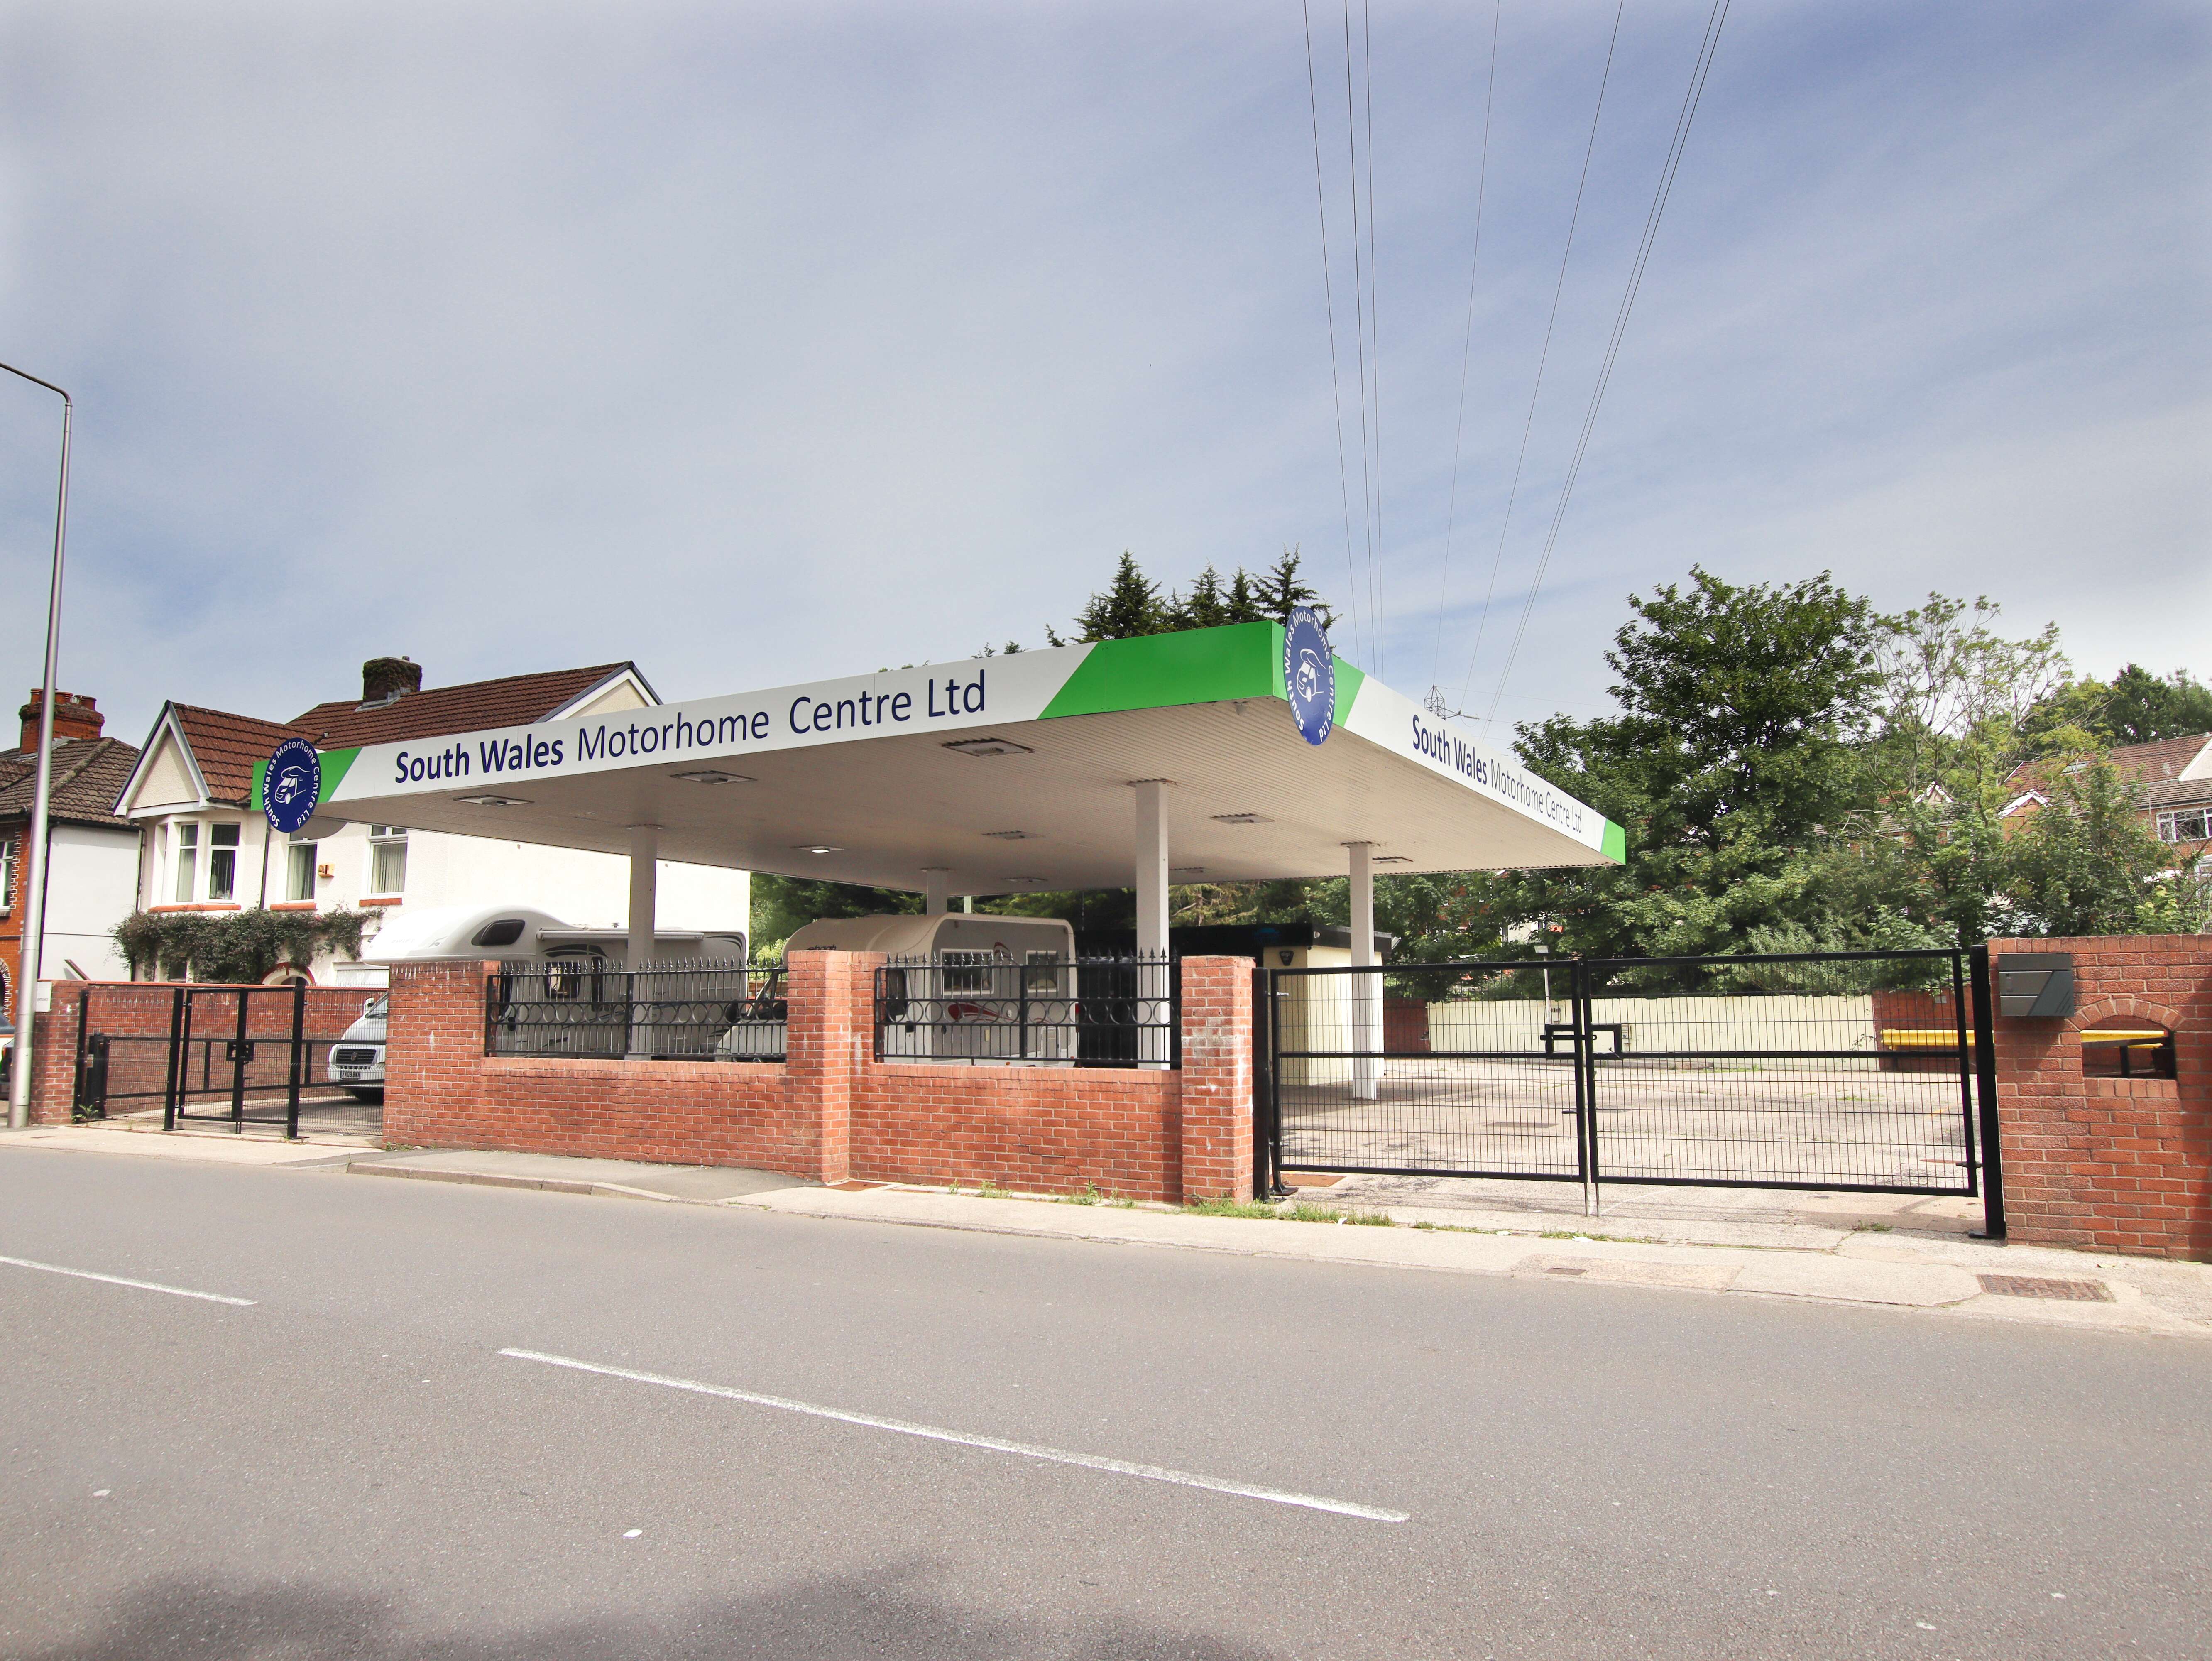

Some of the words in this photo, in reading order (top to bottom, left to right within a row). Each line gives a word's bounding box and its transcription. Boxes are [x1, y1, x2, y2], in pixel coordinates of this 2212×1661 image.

[1285, 624, 1294, 674] Wales
[1293, 610, 1330, 660] Motorhome
[395, 743, 470, 783] South
[480, 734, 563, 773] Wales
[578, 712, 769, 761] Motorhome
[790, 693, 912, 734] Centre
[927, 669, 986, 718] Ltd
[1287, 680, 1304, 731] South
[1319, 720, 1330, 742] Ltd
[276, 740, 316, 765] Motorhome
[263, 758, 276, 795] Wales
[308, 766, 320, 808] Centre
[1412, 714, 1450, 766] South
[1454, 737, 1488, 785] Wales
[1491, 758, 1544, 814] Motorhome
[1546, 791, 1570, 828] Centre
[1572, 806, 1582, 834] Ltd
[264, 797, 280, 827] South
[296, 809, 310, 827] Ltd
